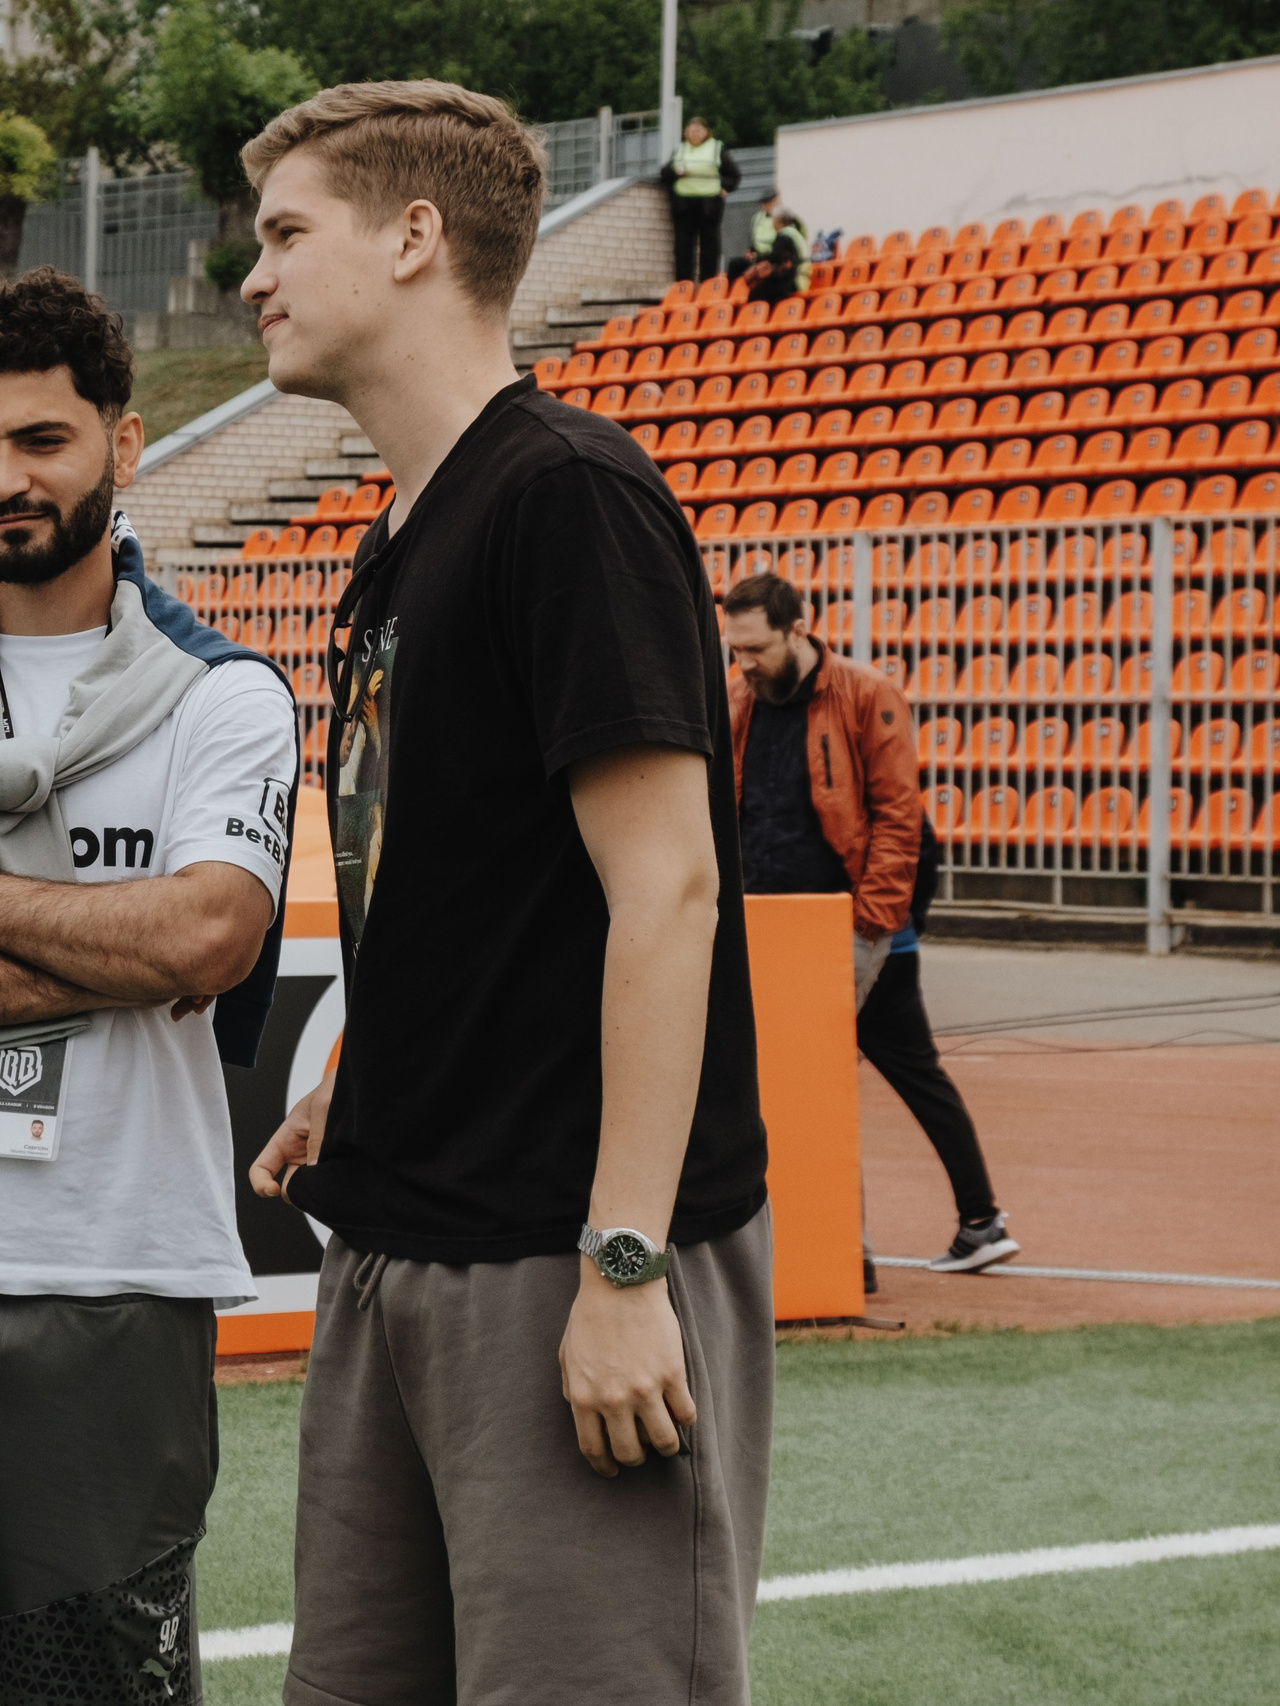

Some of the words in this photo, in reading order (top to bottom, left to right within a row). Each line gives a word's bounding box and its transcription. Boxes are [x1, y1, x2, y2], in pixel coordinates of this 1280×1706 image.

[361, 616, 398, 662] SVE
[226, 818, 285, 876] BetB
[159, 1615, 179, 1654] 98
